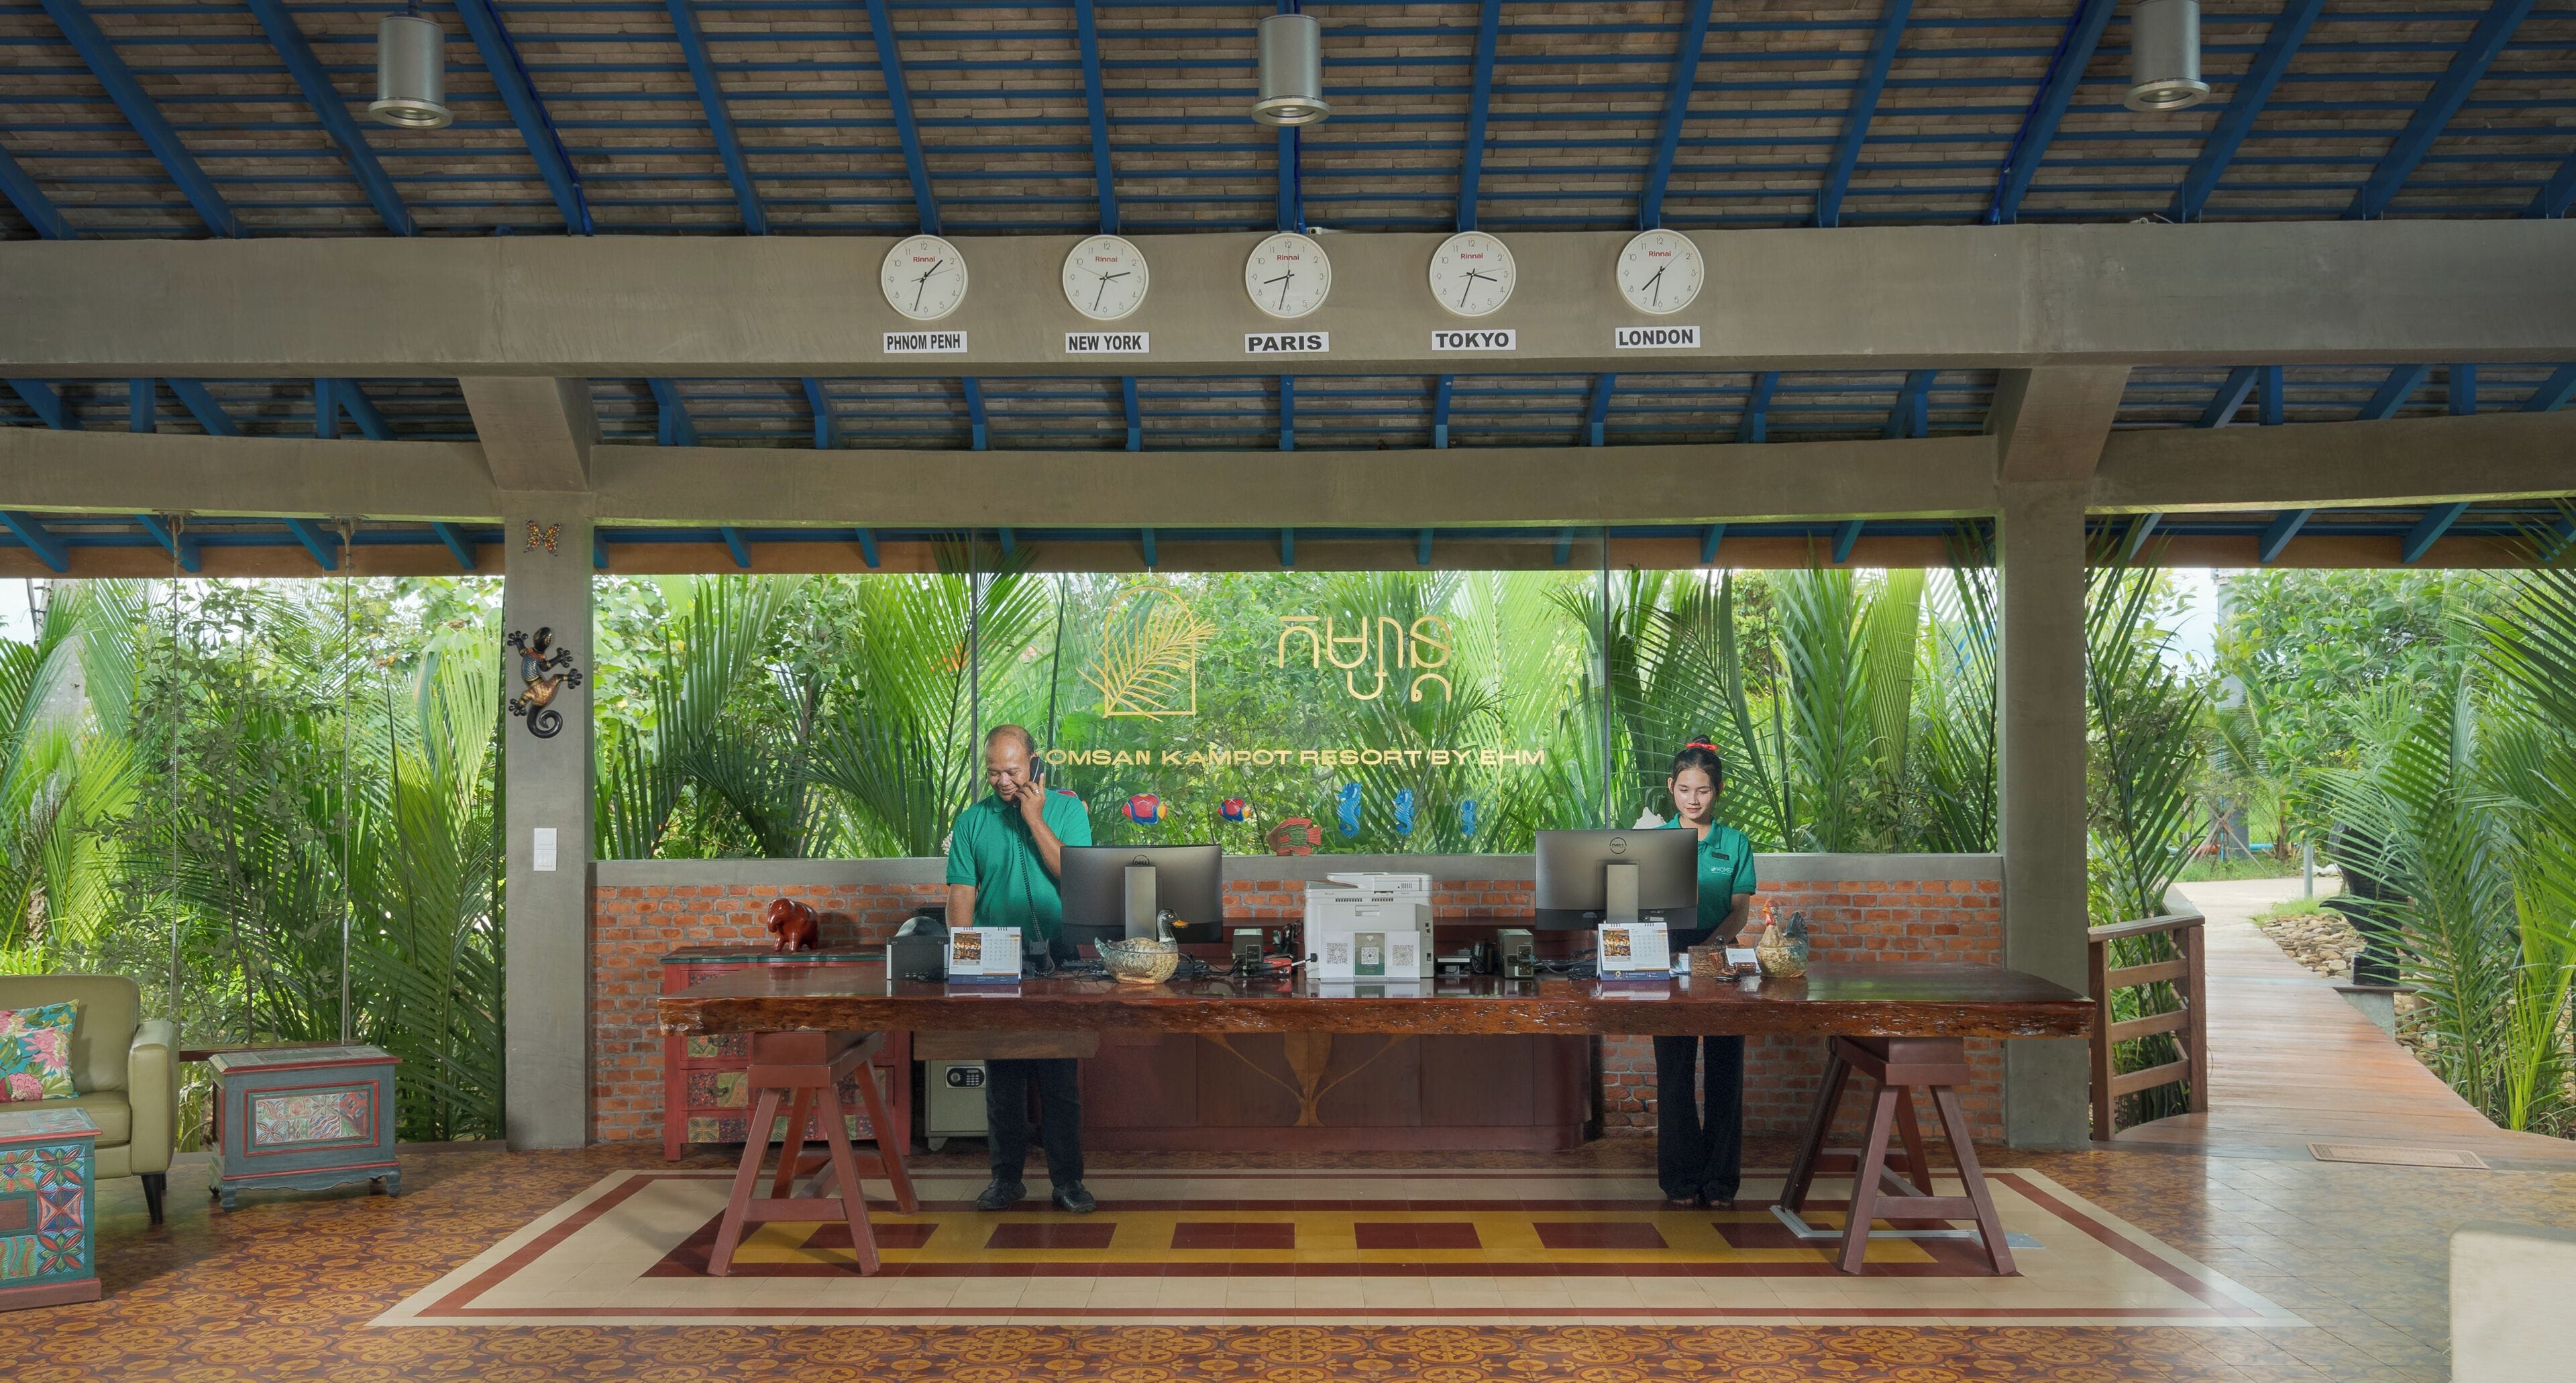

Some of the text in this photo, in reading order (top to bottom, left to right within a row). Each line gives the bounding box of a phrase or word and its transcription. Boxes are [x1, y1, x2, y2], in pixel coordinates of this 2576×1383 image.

[888, 334, 960, 350] PHNOM PENH
[1069, 335, 1142, 350] NEW YORK
[1248, 335, 1322, 351] PARIS
[1436, 333, 1509, 348] TOKYO
[1619, 329, 1693, 345] LONDON
[1037, 749, 1545, 765] OMSAN KAMPOT RESORT BY EHM
